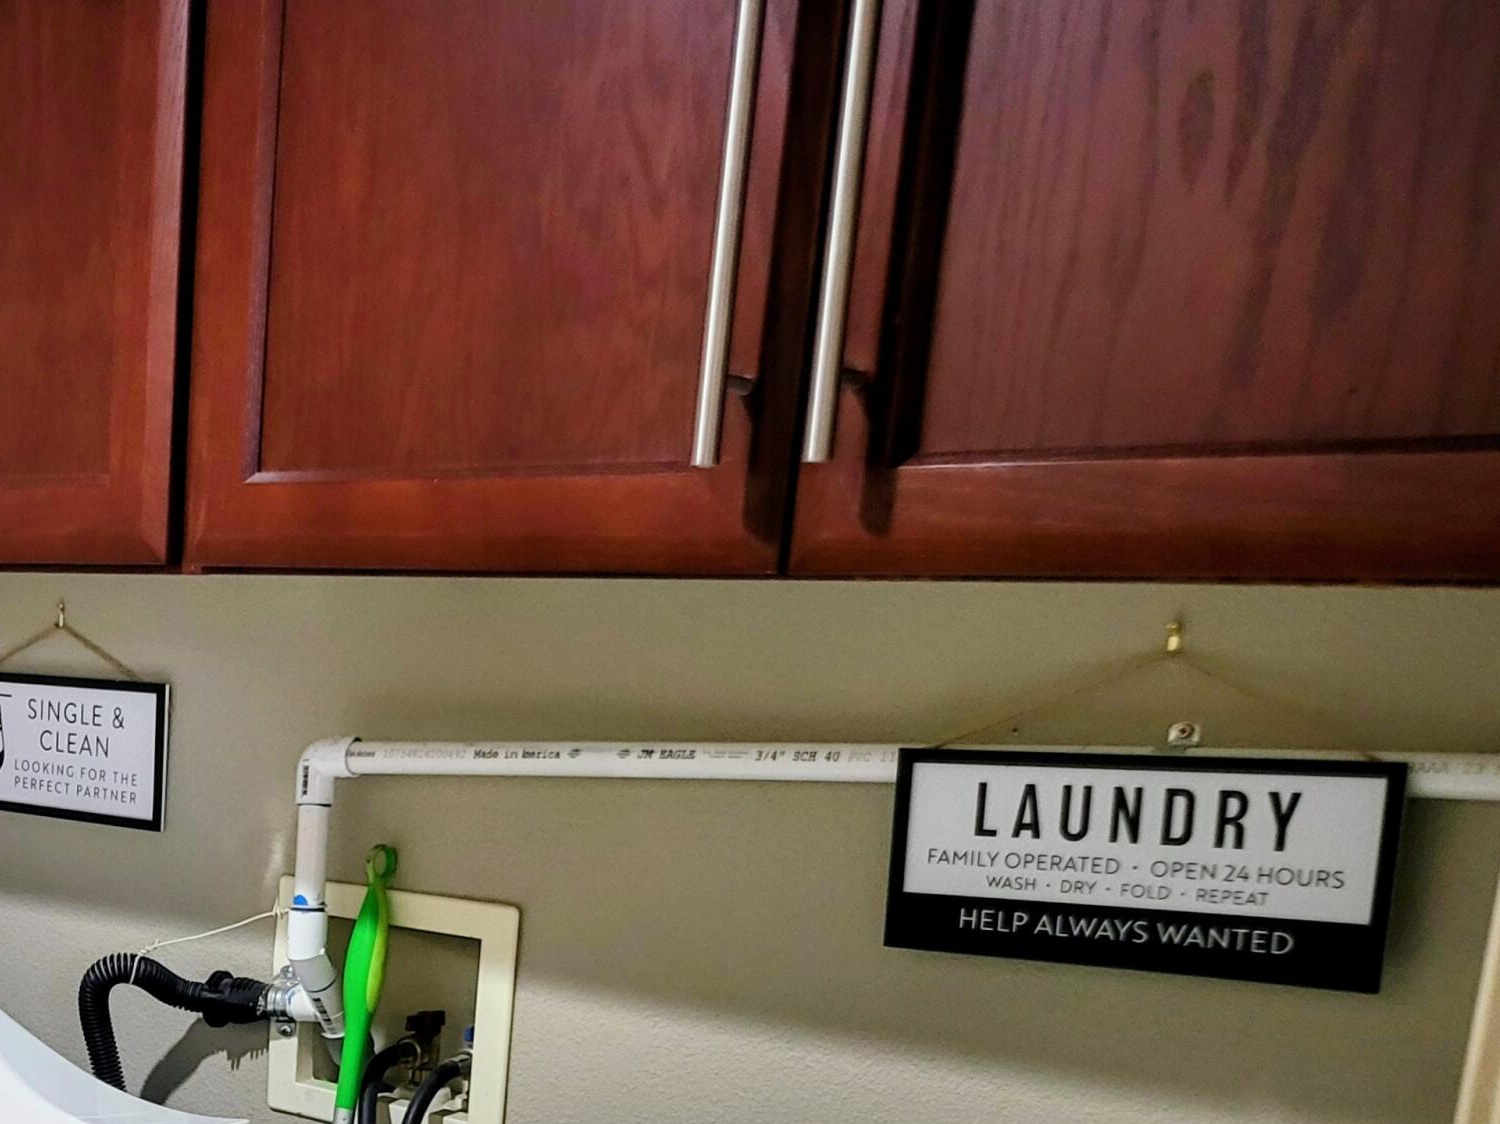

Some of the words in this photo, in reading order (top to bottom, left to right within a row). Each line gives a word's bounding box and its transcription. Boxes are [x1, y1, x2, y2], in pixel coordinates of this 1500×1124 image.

[27, 698, 103, 727] SINGLE
[112, 706, 125, 730] &
[39, 729, 109, 759] CLEAN
[473, 750, 499, 759] Made
[504, 750, 518, 759] in
[659, 749, 697, 760] EAGLE
[755, 750, 785, 762] 3/4"
[792, 750, 818, 762] SCH
[824, 750, 841, 762] 40
[14, 758, 75, 778] LOOKING
[80, 766, 106, 782] FOR
[112, 771, 138, 787] THE
[13, 775, 70, 795] PERFECT
[76, 783, 137, 804] PARTNER
[974, 782, 1303, 852] LAUNDRY
[927, 848, 1000, 868] FAMILY
[1004, 851, 1121, 875] OPERATED
[1150, 860, 1218, 880] OPEN
[1223, 864, 1250, 883] 24
[1256, 866, 1345, 889] HOURS
[986, 875, 1037, 891] WASH
[1059, 879, 1098, 894] DRY
[1120, 883, 1172, 900] FOLD
[1195, 887, 1270, 906] REPEAT
[958, 908, 1029, 933] HELP
[1033, 914, 1149, 943] ALWAYS
[1156, 922, 1295, 955] WANTED
